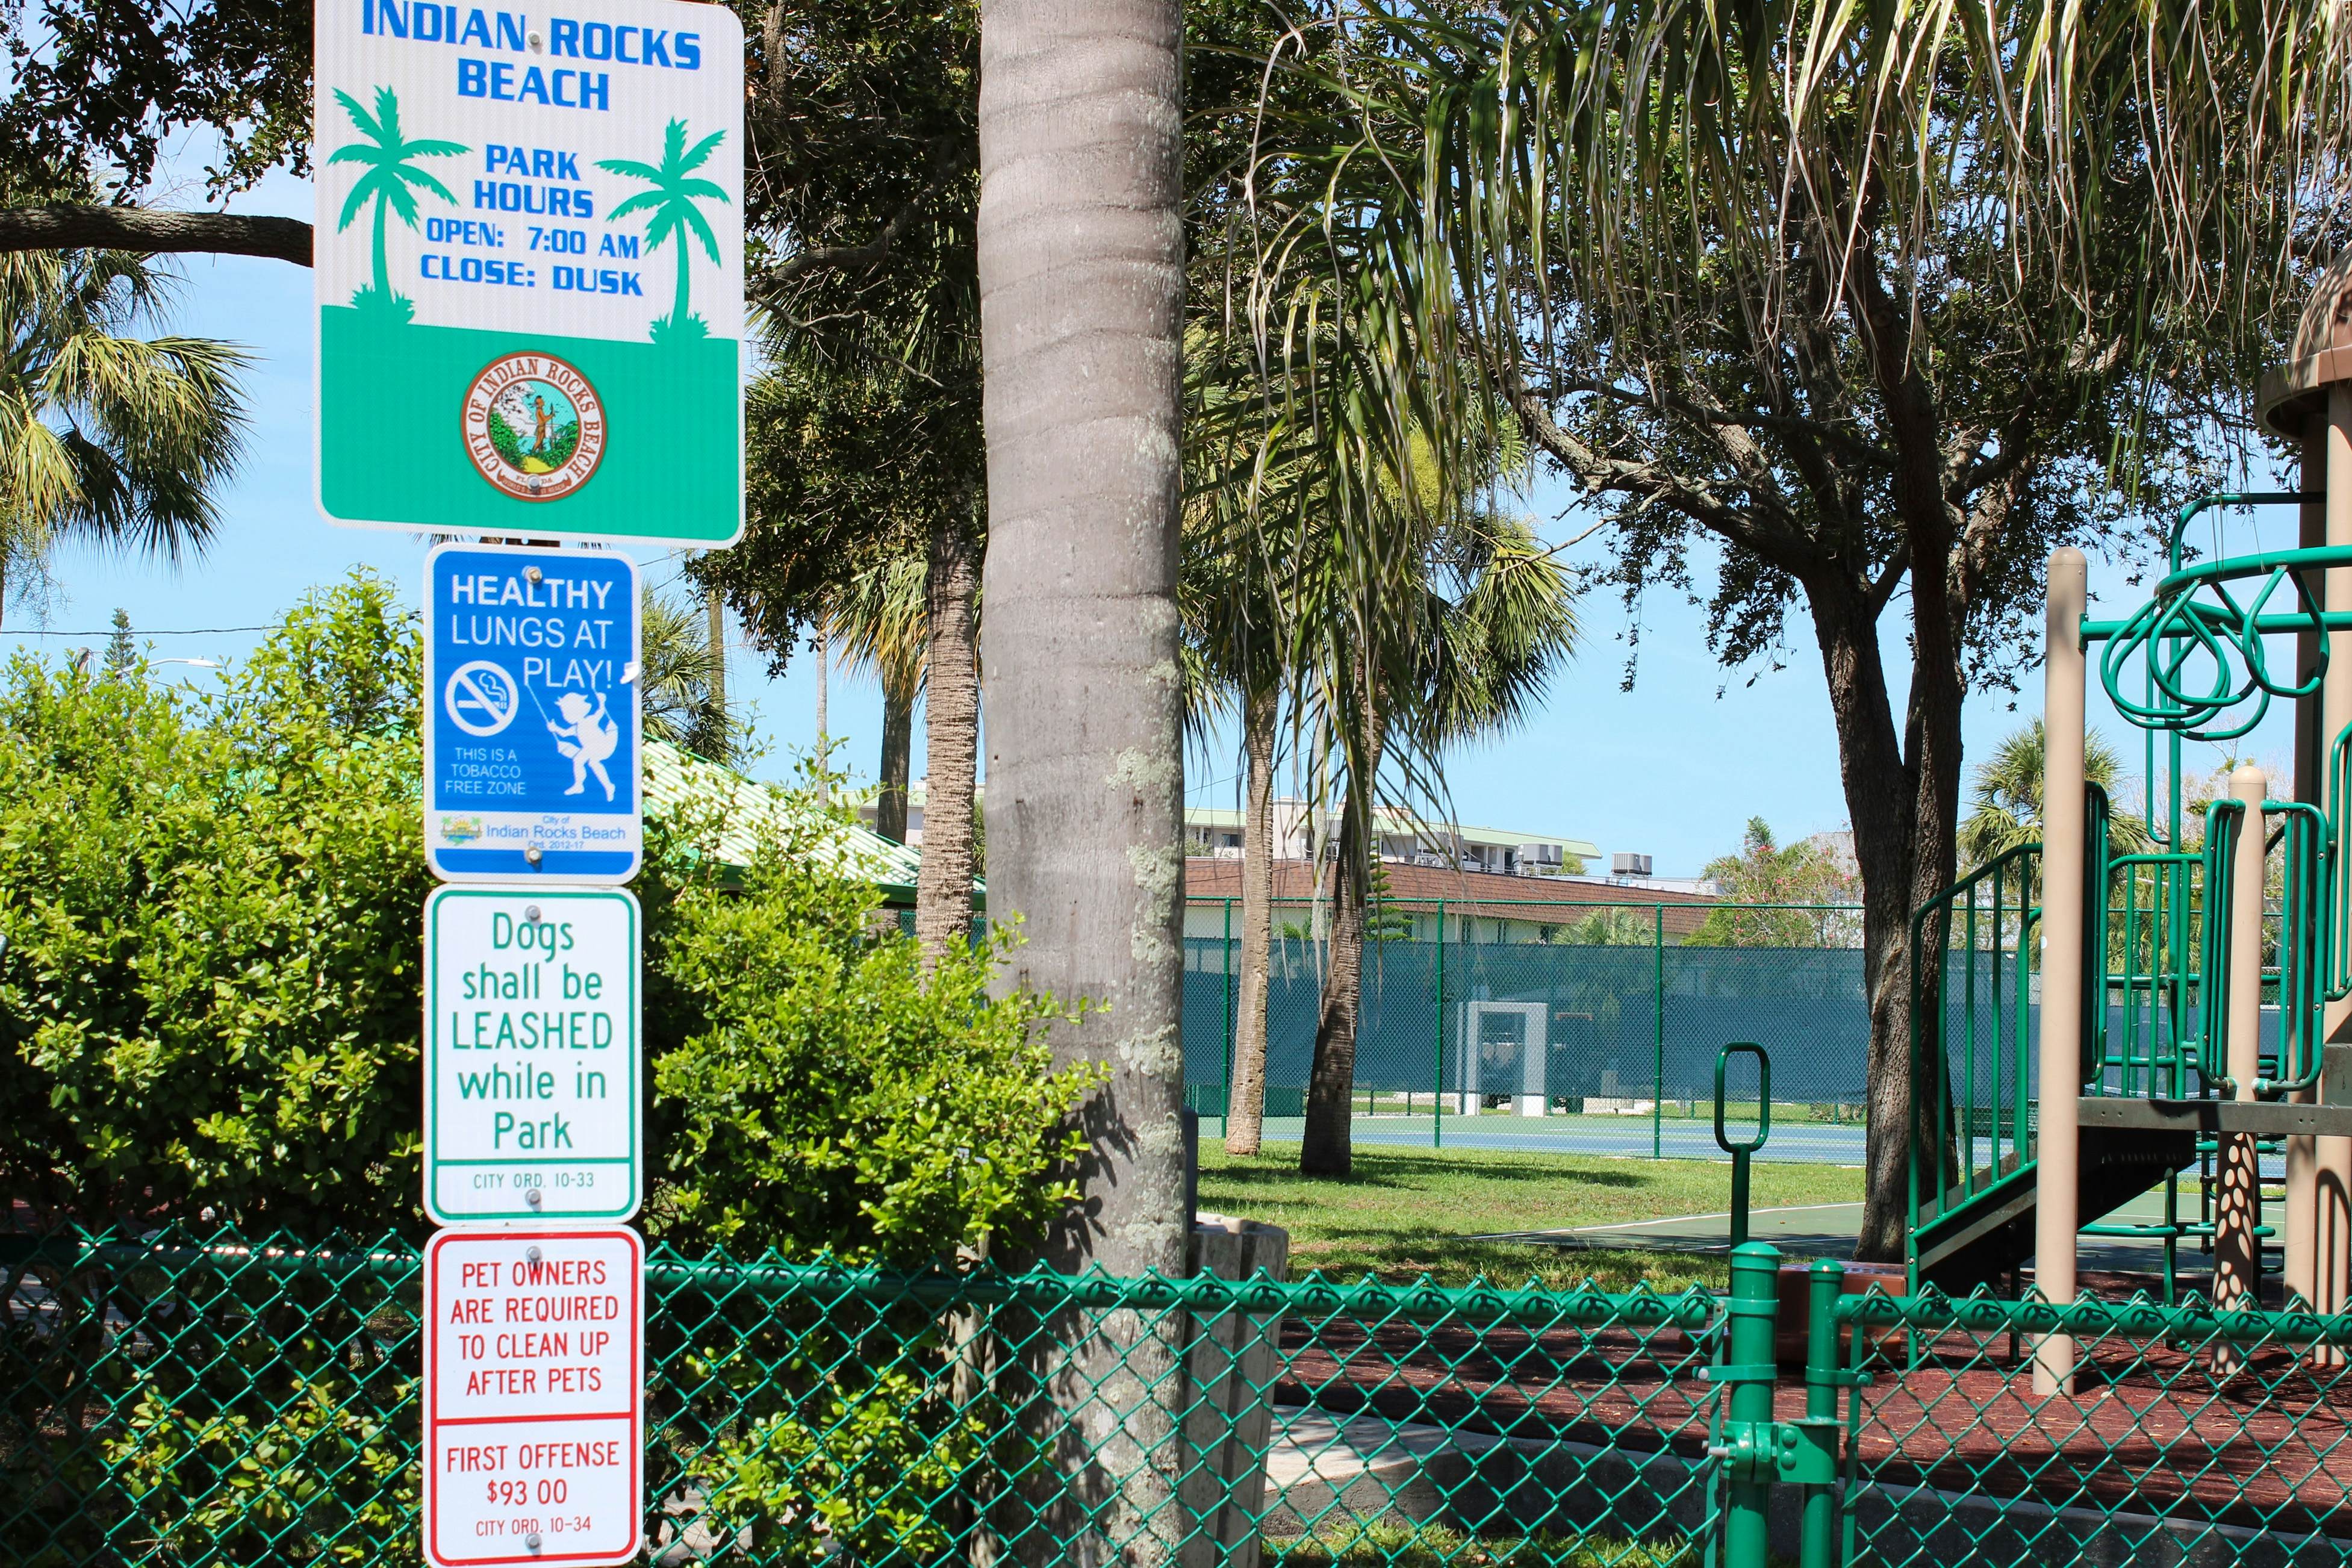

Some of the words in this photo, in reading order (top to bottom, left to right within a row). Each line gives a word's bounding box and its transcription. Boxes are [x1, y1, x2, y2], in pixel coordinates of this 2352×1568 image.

[362, 0, 526, 52] INDIAN
[550, 17, 701, 70] ROCKS
[457, 57, 612, 111] BEACH
[485, 144, 580, 181] PARK
[474, 180, 593, 219] HOURS
[426, 217, 503, 248] OPEN:
[529, 226, 586, 255] 7:00
[599, 233, 639, 260] AM
[420, 254, 535, 287] CLOSE:
[552, 265, 642, 297] DUSK
[478, 358, 539, 397] INDIAN
[547, 362, 596, 413] ROCKS
[468, 399, 487, 423] OF
[469, 432, 500, 473] CITY
[569, 420, 600, 479] BEACH
[452, 574, 614, 610] HEALTHY
[452, 614, 565, 648] LUNGS
[573, 620, 614, 649] AT
[523, 656, 612, 689] PLAY!
[450, 764, 521, 779] TOBACCO
[455, 747, 487, 761] THIS
[491, 748, 505, 762] IS
[507, 749, 518, 762] A
[444, 780, 482, 794] FREE
[487, 780, 526, 795] ZONE
[485, 824, 529, 839] Indian
[532, 824, 577, 839] Rocks
[581, 825, 626, 840] Beach
[543, 815, 560, 825] City
[562, 815, 570, 824] of
[491, 912, 574, 963] Dogs
[462, 963, 538, 1001] shall
[562, 963, 602, 1001] be
[452, 1012, 612, 1050] LEASHED
[457, 1061, 553, 1100] while
[575, 1060, 606, 1099] in
[494, 1112, 571, 1150] Park
[473, 1173, 505, 1189] CITY
[512, 1172, 546, 1190] ORD.
[553, 1171, 595, 1190] 10-33
[462, 1262, 502, 1288] PET
[512, 1260, 606, 1287] OWNERS
[450, 1298, 494, 1324] ARE
[506, 1295, 619, 1323] REQUIRED
[459, 1334, 485, 1360] TO
[496, 1332, 568, 1359] CLEAN
[580, 1331, 610, 1357] UP
[466, 1368, 537, 1396] AFTER
[548, 1366, 602, 1393] PETS
[447, 1445, 509, 1472] FIRST
[519, 1440, 620, 1470] OFFENSE
[475, 1519, 505, 1537] CITY
[511, 1517, 543, 1535] ORD.
[550, 1514, 593, 1532] 10-34
